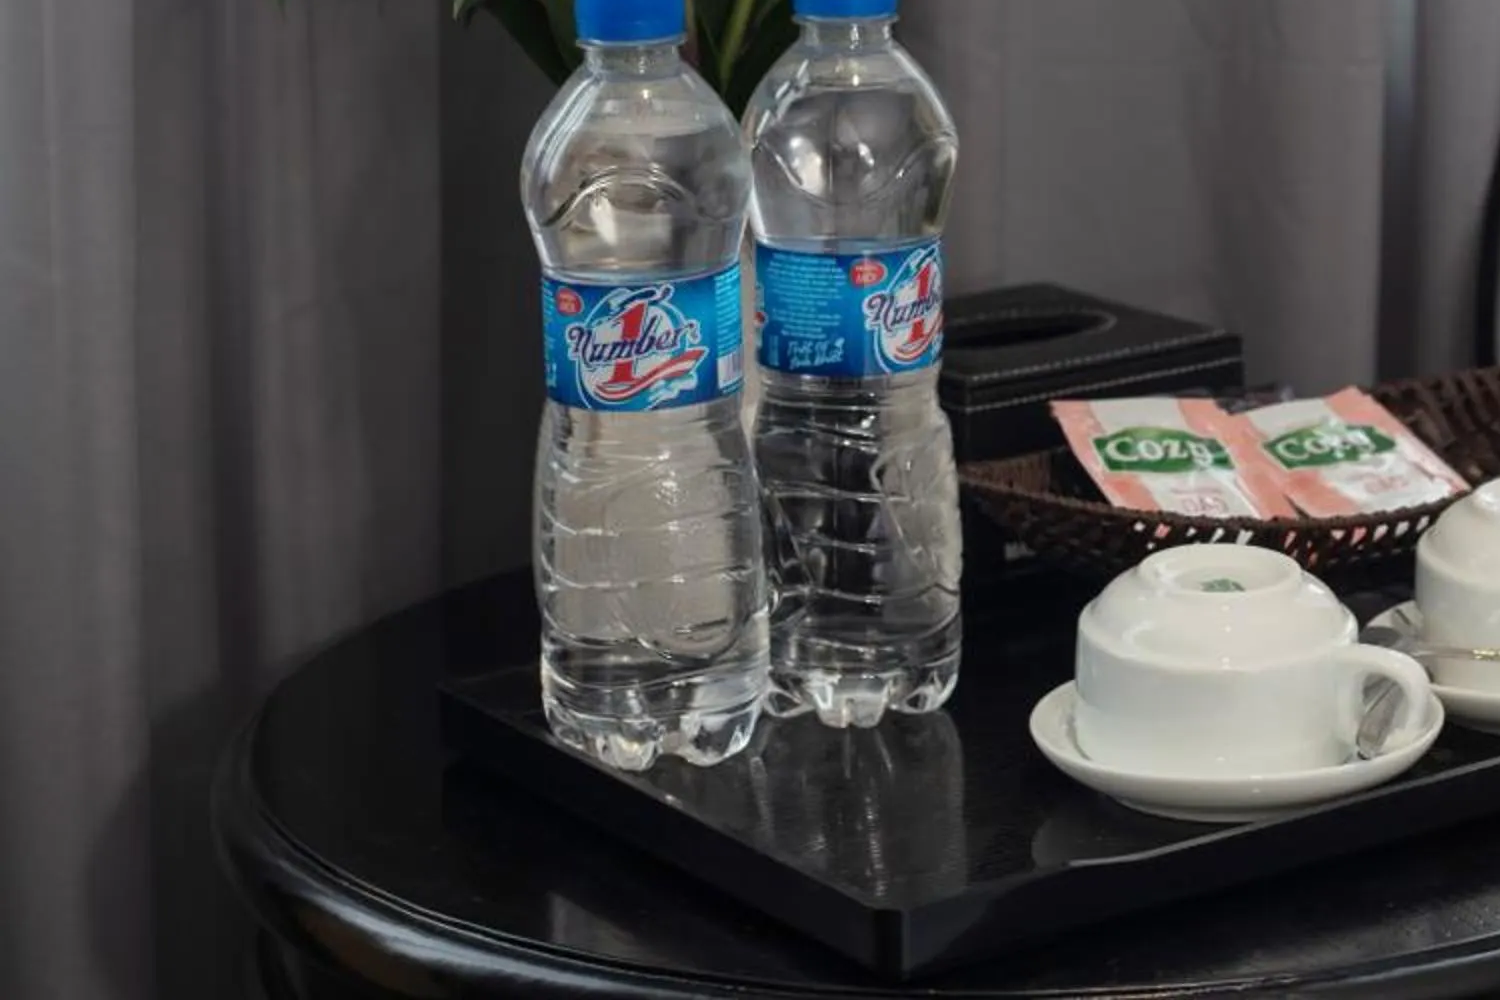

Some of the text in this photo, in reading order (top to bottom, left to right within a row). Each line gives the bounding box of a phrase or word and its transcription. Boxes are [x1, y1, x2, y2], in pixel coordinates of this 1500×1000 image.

[865, 284, 939, 334] Numb
[568, 315, 698, 369] Number
[606, 301, 646, 384] 1
[1105, 437, 1214, 467] Cozy
